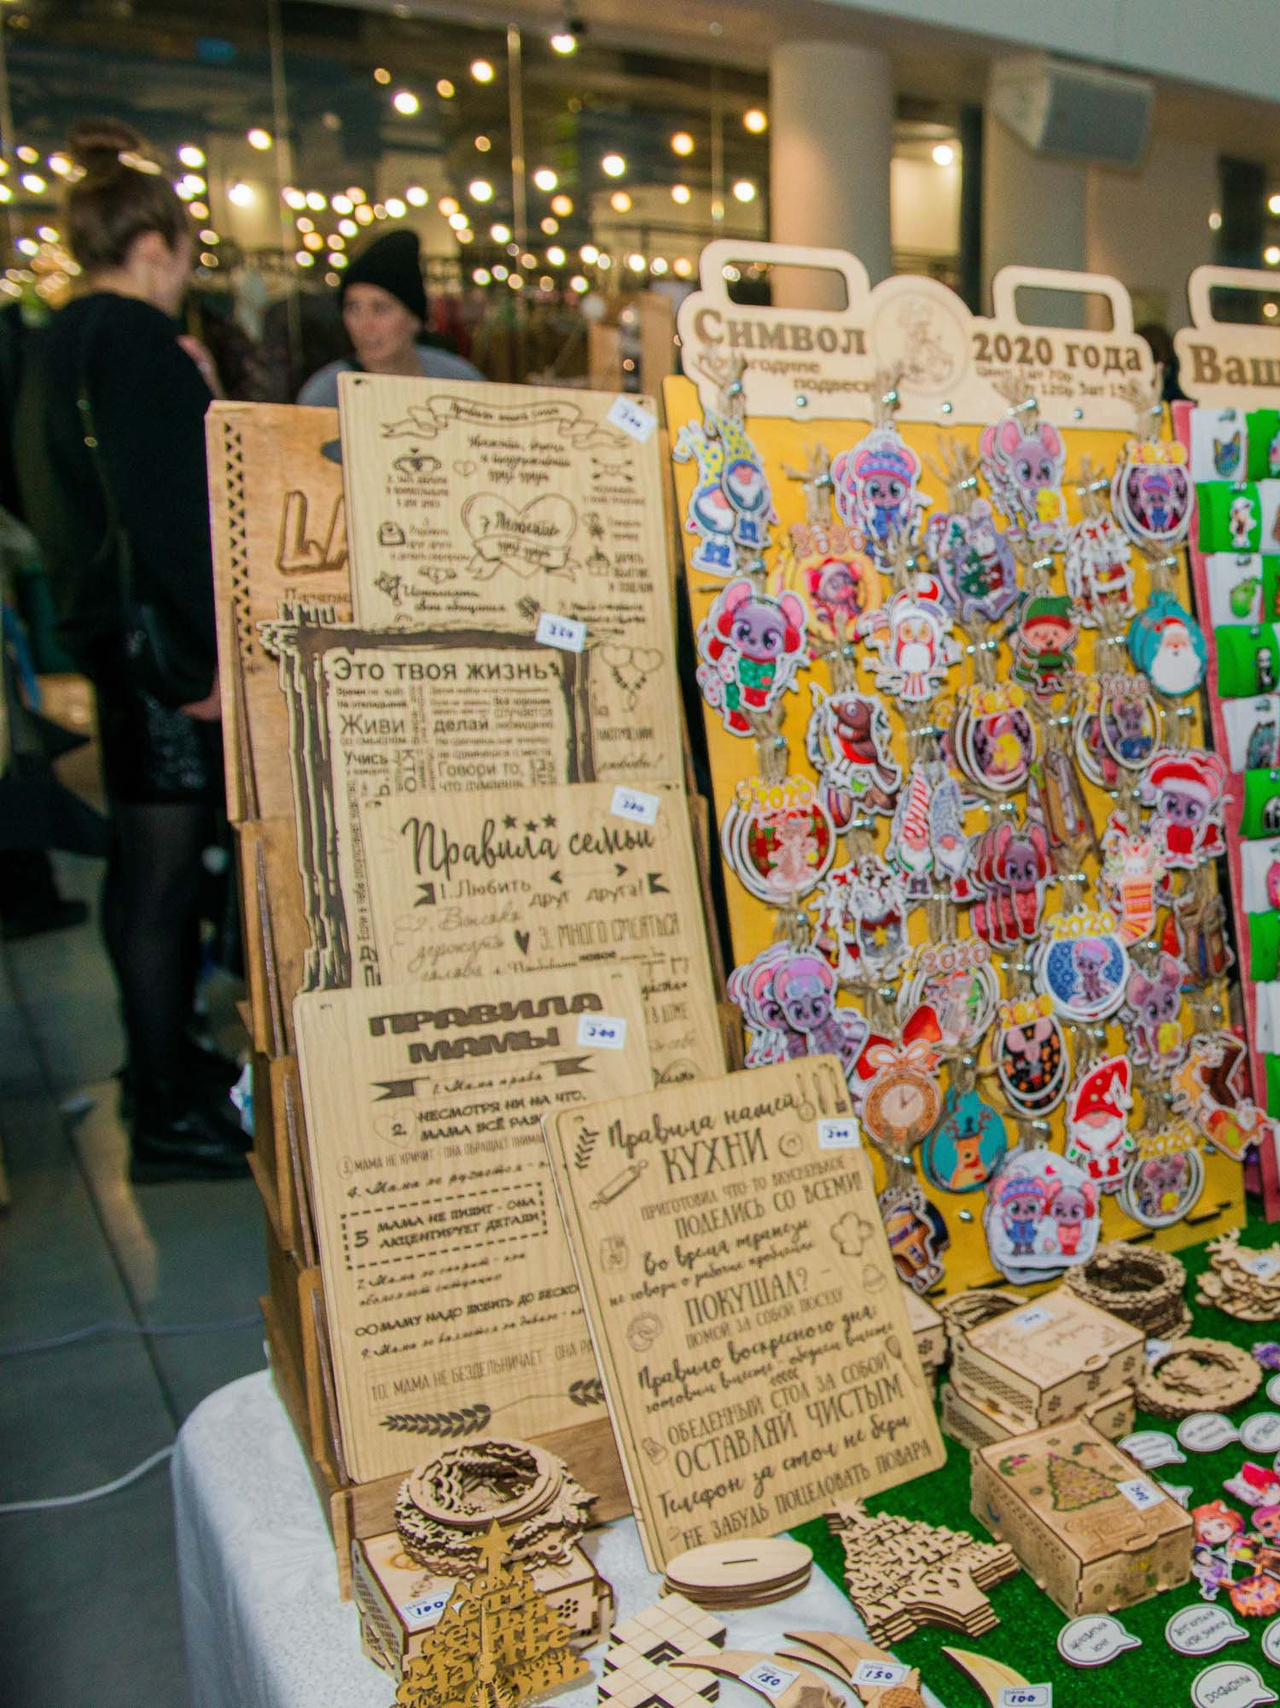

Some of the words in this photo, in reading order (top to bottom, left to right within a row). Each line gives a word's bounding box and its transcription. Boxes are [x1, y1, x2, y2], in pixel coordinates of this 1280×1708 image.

[694, 309, 867, 355] Символ
[972, 333, 1053, 366] 2020
[1065, 342, 1142, 376] года
[333, 657, 384, 681] Это
[393, 662, 458, 681] твоя
[467, 662, 548, 681] жизнь
[341, 714, 405, 735] Живи
[432, 720, 490, 735] делай
[343, 750, 389, 767] Учись
[438, 762, 497, 778] Говори
[402, 816, 559, 881] Правила
[569, 827, 656, 857] семьи
[459, 878, 532, 899] Любить
[529, 889, 571, 908] друг
[584, 878, 642, 903] друга!
[558, 922, 607, 947] МНОГО
[610, 911, 680, 943] СМЕЯТЬСЯ
[1050, 911, 1115, 940] 2020
[578, 949, 616, 961] новое
[368, 992, 604, 1038] ПРАВИЛА
[408, 1026, 561, 1065] МАМЫ
[417, 1101, 502, 1121] НЕСМОТРЯ
[506, 1098, 525, 1110] НИ
[530, 1095, 552, 1107] НА
[608, 1112, 715, 1160] Правила
[724, 1091, 799, 1125] нашей
[420, 1126, 473, 1142] МАМА
[476, 1117, 506, 1134] ВСЁ
[354, 1158, 384, 1173] МАМА
[386, 1155, 399, 1168] НЕ
[660, 1126, 769, 1185] КУХНИ
[640, 1189, 719, 1222] ПРИГОТОВИЛ
[722, 1175, 768, 1199] ЧТО-ТО
[673, 1199, 766, 1241] ПОДЕЛИСЬ
[773, 1187, 797, 1213] СО
[803, 1171, 863, 1205] ВСЕМИ!
[353, 1230, 369, 1249] 5
[376, 1217, 425, 1235] МАМА
[429, 1210, 447, 1225] НЕ
[506, 1197, 537, 1212] ОНА
[380, 1221, 482, 1250] АКЦЕНТИРУЕТ
[644, 1249, 669, 1277] Во
[675, 1239, 731, 1271] время
[631, 1279, 679, 1300] говори
[694, 1260, 745, 1288] рабочих
[683, 1265, 809, 1328] ПОКУШАЛ?
[380, 1315, 422, 1333] МАМУ
[425, 1307, 463, 1325] НАДО
[517, 1293, 535, 1307] ДО
[685, 1321, 731, 1351] ПОМОЙ
[737, 1317, 753, 1334] ЗА
[755, 1301, 797, 1328] СОБОЙ
[393, 1375, 430, 1395] МАМА
[433, 1369, 448, 1387] НЕ
[451, 1349, 543, 1381] БЕЗДЕЛЬНИЧАЕТ
[638, 1356, 722, 1398] Правило
[727, 1319, 835, 1366] воскресного
[645, 1381, 718, 1416] готовим
[719, 1361, 775, 1391] вместе
[788, 1338, 843, 1367] обедаем
[844, 1321, 895, 1348] вместе
[667, 1393, 765, 1447] ОБЕДЕННЫЙ
[769, 1381, 812, 1412] СТОЛ
[817, 1371, 837, 1392] ЗА
[840, 1351, 890, 1384] СОБОЙ
[674, 1409, 799, 1480] ОСТАВЛЯЙ
[805, 1372, 905, 1429] ЧИСТЫМ
[658, 1478, 746, 1519] Телефон
[753, 1462, 777, 1499] за
[782, 1441, 839, 1471] стол
[843, 1429, 865, 1449] не
[869, 1412, 913, 1442] бери
[682, 1528, 704, 1551] НЕ
[709, 1503, 771, 1541] ЗАБУДЬ
[773, 1460, 872, 1515] ПОЦЕЛОВАТЬ
[875, 1436, 933, 1475] ПОВАРА
[416, 1600, 444, 1616] 100
[757, 1672, 781, 1687] 150
[865, 1669, 894, 1681] 150
[1010, 1694, 1036, 1704] 100
